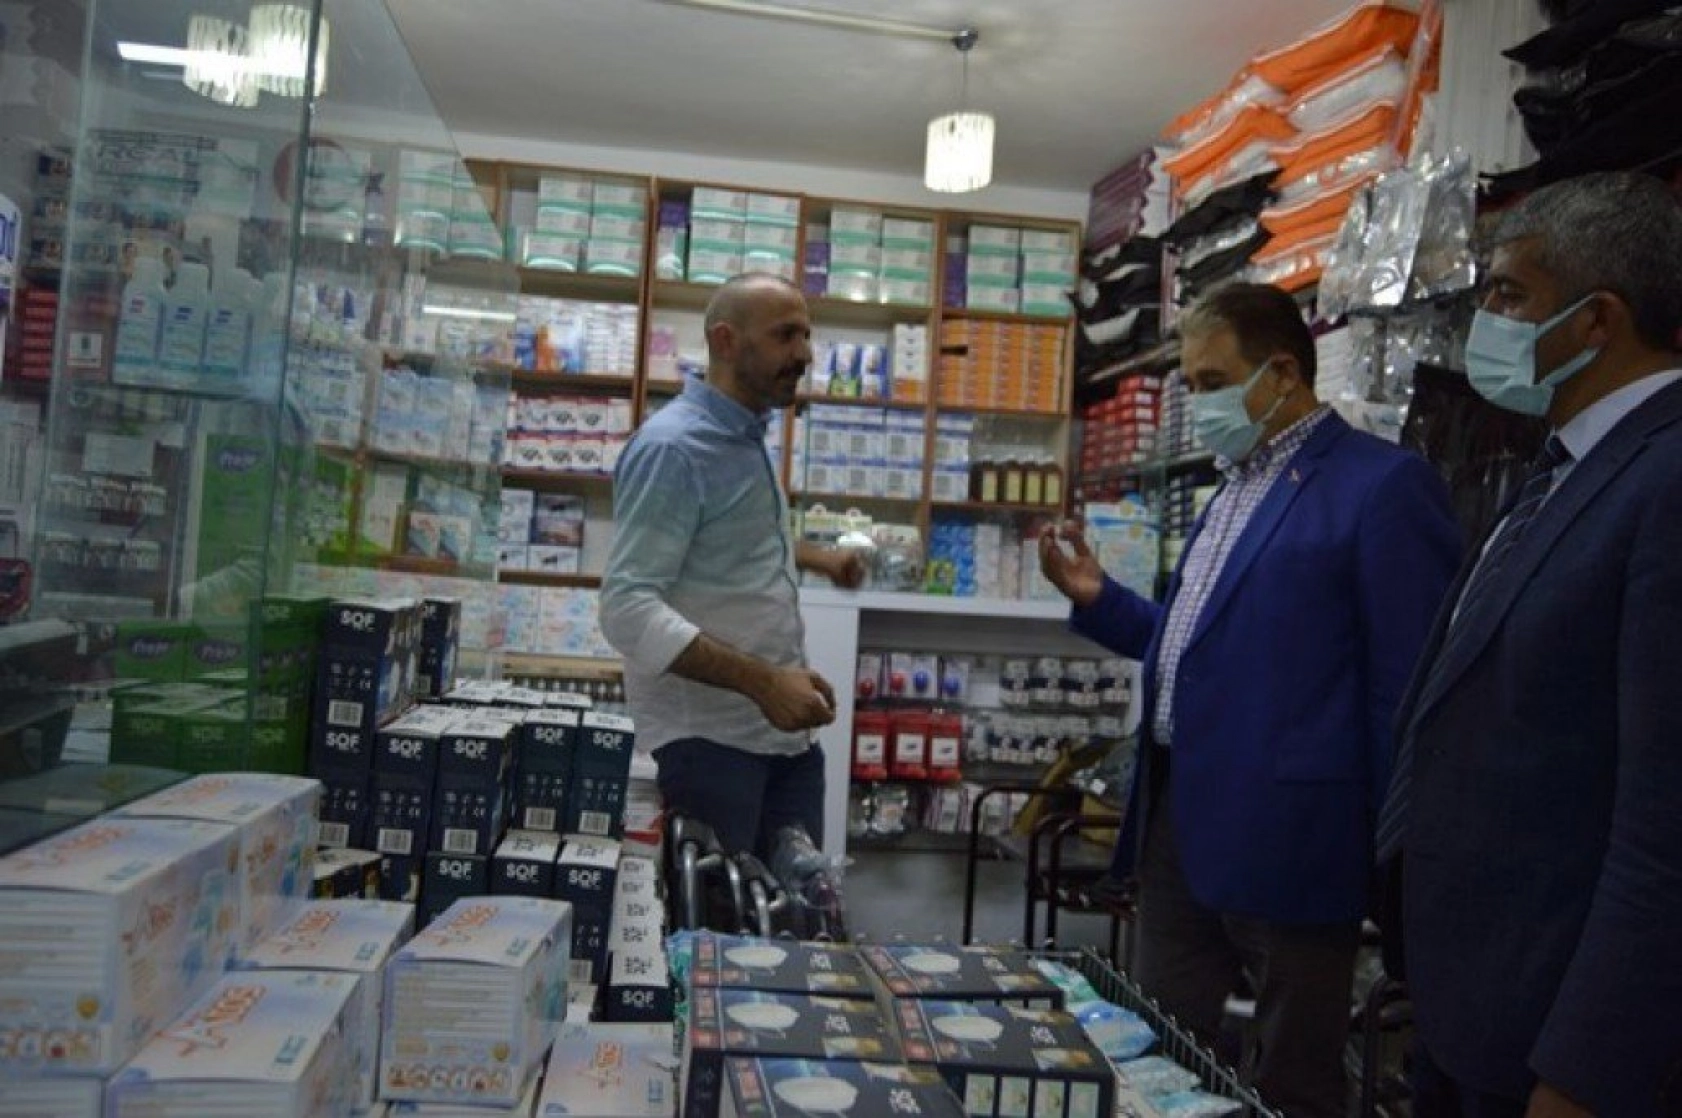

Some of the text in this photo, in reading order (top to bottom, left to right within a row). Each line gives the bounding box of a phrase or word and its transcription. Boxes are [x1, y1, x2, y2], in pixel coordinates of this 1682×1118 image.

[340, 610, 375, 631] SQF
[326, 732, 359, 751] SQF
[535, 726, 564, 743] SQF
[593, 731, 623, 748] SQF
[388, 738, 422, 758] SQF
[454, 739, 487, 758] SQF
[439, 859, 472, 879] SQF
[506, 863, 539, 880] SQF
[568, 869, 601, 887] SQF
[622, 990, 654, 1007] SQF
